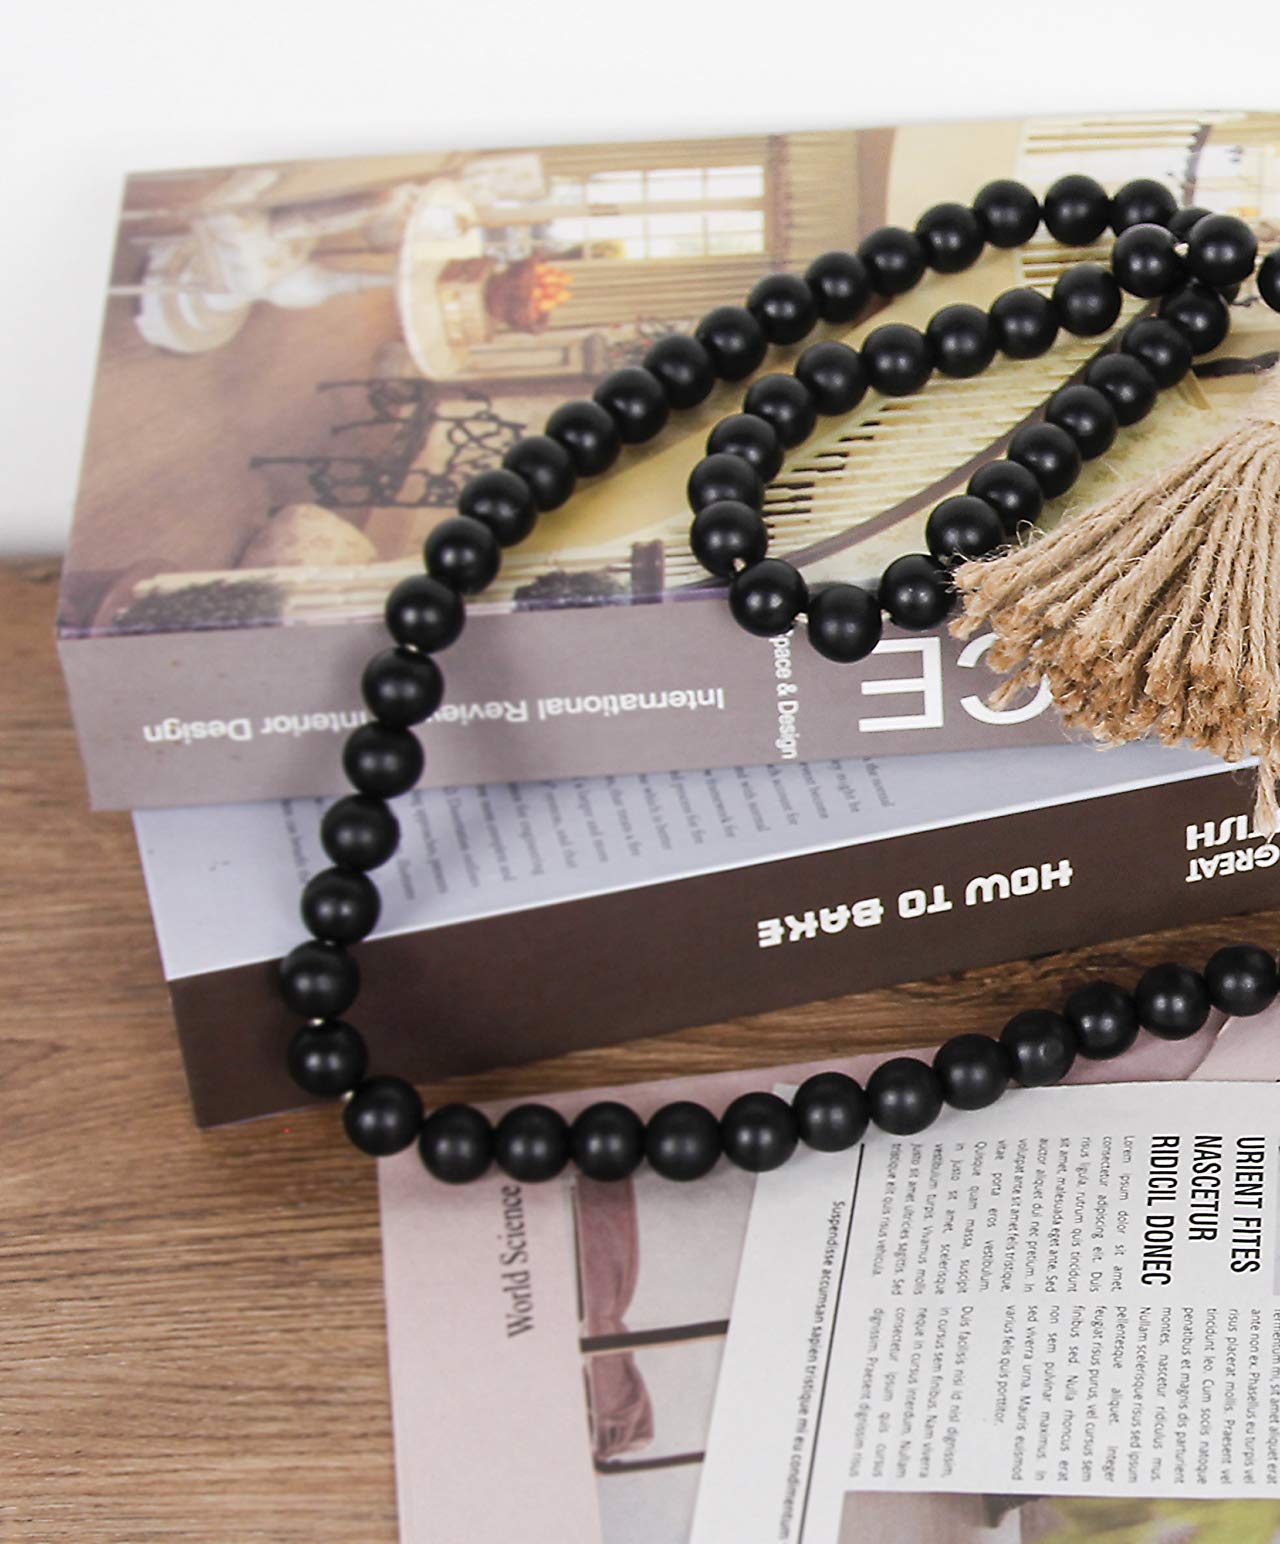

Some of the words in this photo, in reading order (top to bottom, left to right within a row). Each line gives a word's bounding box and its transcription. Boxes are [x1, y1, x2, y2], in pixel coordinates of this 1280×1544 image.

[769, 630, 793, 679] pace
[538, 688, 725, 720] International
[776, 683, 798, 697] &
[143, 717, 252, 745] Design
[775, 701, 800, 759] Design
[1185, 843, 1280, 882] GREAT
[965, 859, 1074, 906] HOW
[898, 885, 953, 919] TO
[757, 897, 885, 948] BAKE
[1099, 1135, 1114, 1186] consectetur
[1123, 1135, 1136, 1163] Lorem
[1119, 1174, 1131, 1200] ipsum
[1147, 1136, 1180, 1207] RIDICIL
[1188, 1135, 1223, 1241] NASCETUR
[1233, 1137, 1265, 1209] URIENT
[497, 1184, 528, 1266] Science
[823, 1200, 846, 1266] Suspendisse
[1091, 1194, 1110, 1238] adipiscing
[1116, 1210, 1131, 1233] dolor
[1114, 1244, 1126, 1255] sit
[1141, 1216, 1175, 1285] DONEC
[1230, 1217, 1262, 1273] FITES
[815, 1268, 833, 1323] accumsan
[1089, 1271, 1104, 1292] Duis
[501, 1270, 534, 1338] World
[1027, 1304, 1039, 1322] sed
[1090, 1304, 1108, 1338] feugiat
[1228, 1308, 1241, 1332] risus
[1250, 1308, 1262, 1331] ante
[1138, 1306, 1152, 1342] Nullam
[1181, 1306, 1195, 1356] penatibus
[1204, 1307, 1218, 1351] tincidunt
[808, 1325, 823, 1362] sapien
[1024, 1325, 1037, 1359] viverra
[1090, 1341, 1103, 1366] risus
[1224, 1336, 1240, 1376] placerat
[1249, 1332, 1261, 1352] non
[1132, 1343, 1149, 1400] scelerisque
[1157, 1354, 1169, 1397] nascetur
[1181, 1358, 1192, 1369] et
[798, 1364, 818, 1415] tristique
[1176, 1372, 1191, 1409] magnis
[1202, 1378, 1216, 1402] Cum
[1246, 1371, 1261, 1419] Phasellus
[797, 1417, 809, 1433] mi
[1016, 1394, 1032, 1430] Mauris
[1086, 1404, 1099, 1419] vel
[1131, 1402, 1144, 1427] risus
[1153, 1405, 1168, 1449] ridiculus
[1177, 1412, 1190, 1428] dis
[1200, 1407, 1212, 1436] sociis
[1246, 1420, 1256, 1434] eu
[1269, 1397, 1280, 1424] amet
[793, 1435, 805, 1451] eu
[1083, 1421, 1096, 1456] cursus
[1130, 1429, 1142, 1448] sed
[1222, 1418, 1236, 1464] Praesent
[1242, 1436, 1257, 1467] turpis
[1266, 1425, 1280, 1461] aliquet
[1011, 1434, 1026, 1480] euismod
[1082, 1459, 1094, 1482] sem
[1127, 1450, 1142, 1483] ipsum
[1174, 1430, 1187, 1484] parturient
[1195, 1440, 1210, 1484] natoque
[1266, 1462, 1279, 1484] erat
[1220, 1468, 1233, 1484] vel
[1243, 1468, 1256, 1484] vel
[780, 1453, 803, 1539] condimentum
